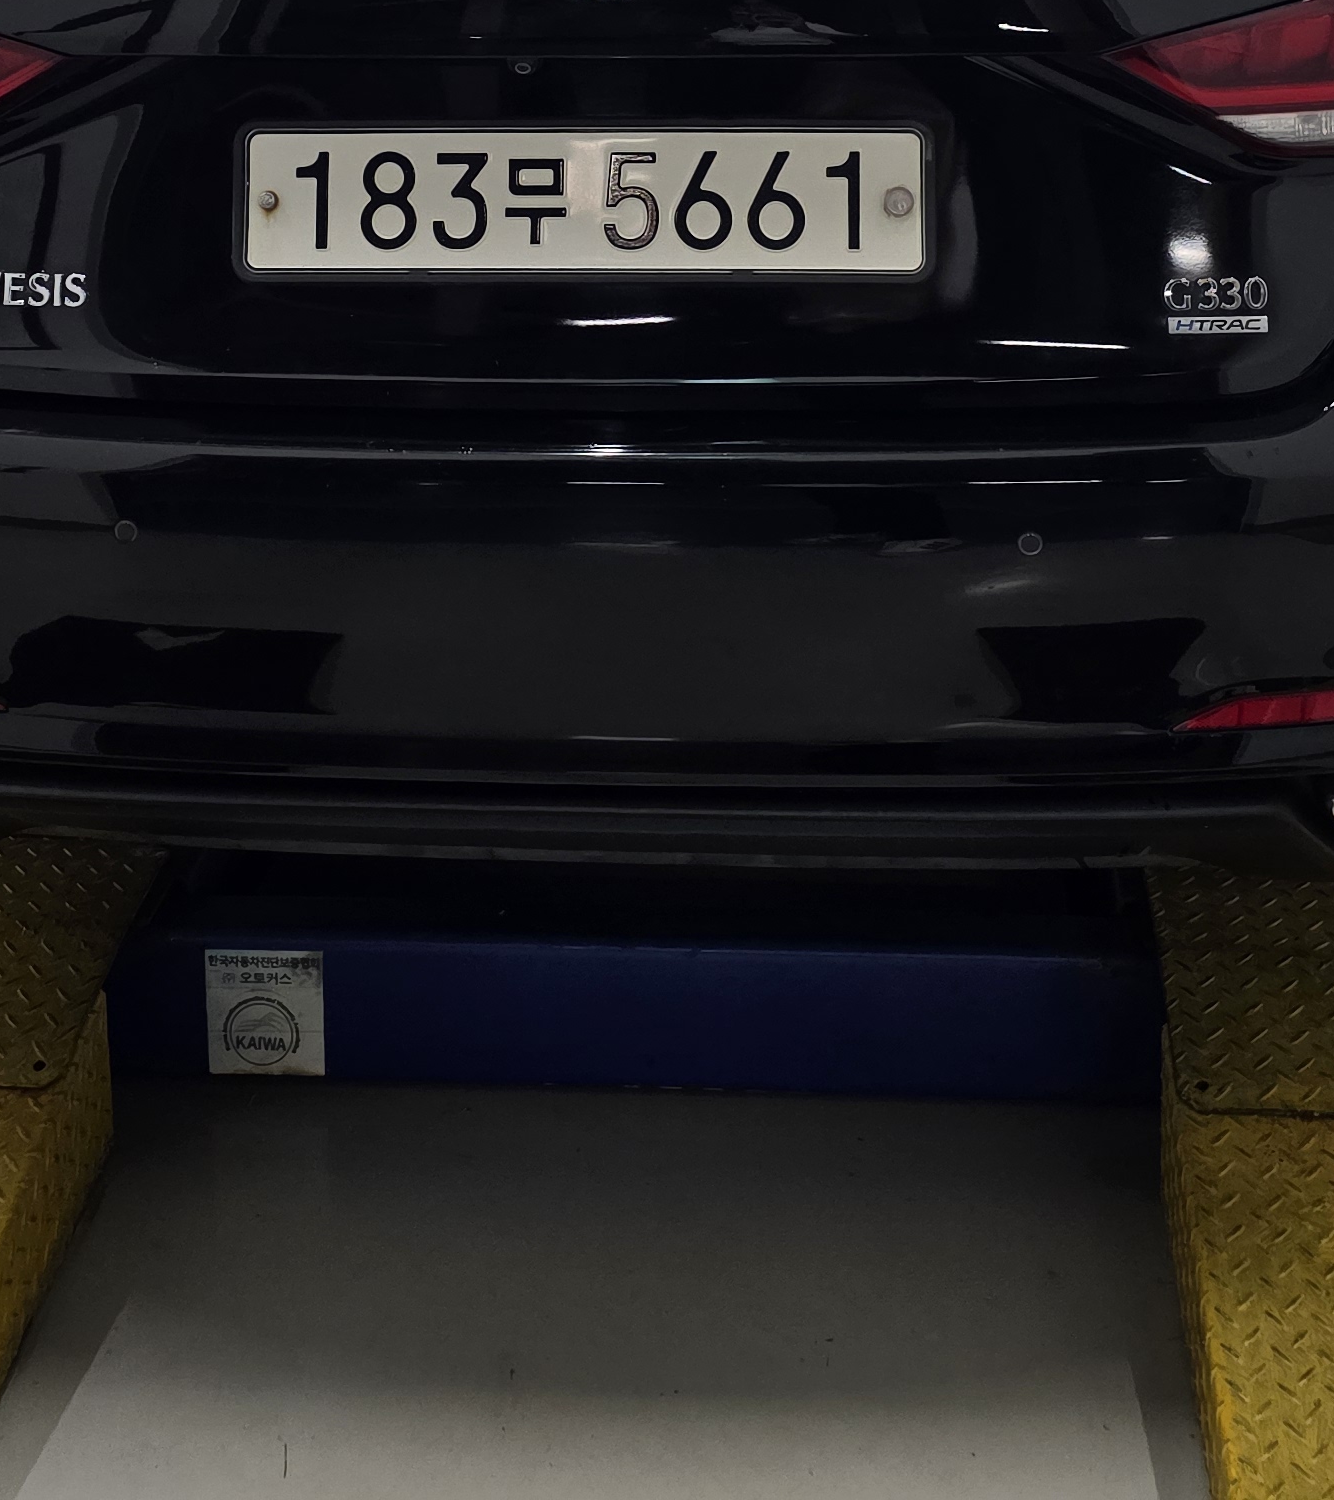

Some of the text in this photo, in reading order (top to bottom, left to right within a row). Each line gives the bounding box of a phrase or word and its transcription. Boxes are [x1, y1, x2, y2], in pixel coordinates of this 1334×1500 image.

[1163, 275, 1269, 311] G330
[1176, 318, 1262, 331] HTRAC
[239, 972, 292, 986] 오토커스
[235, 1035, 287, 1052] KAIWA
